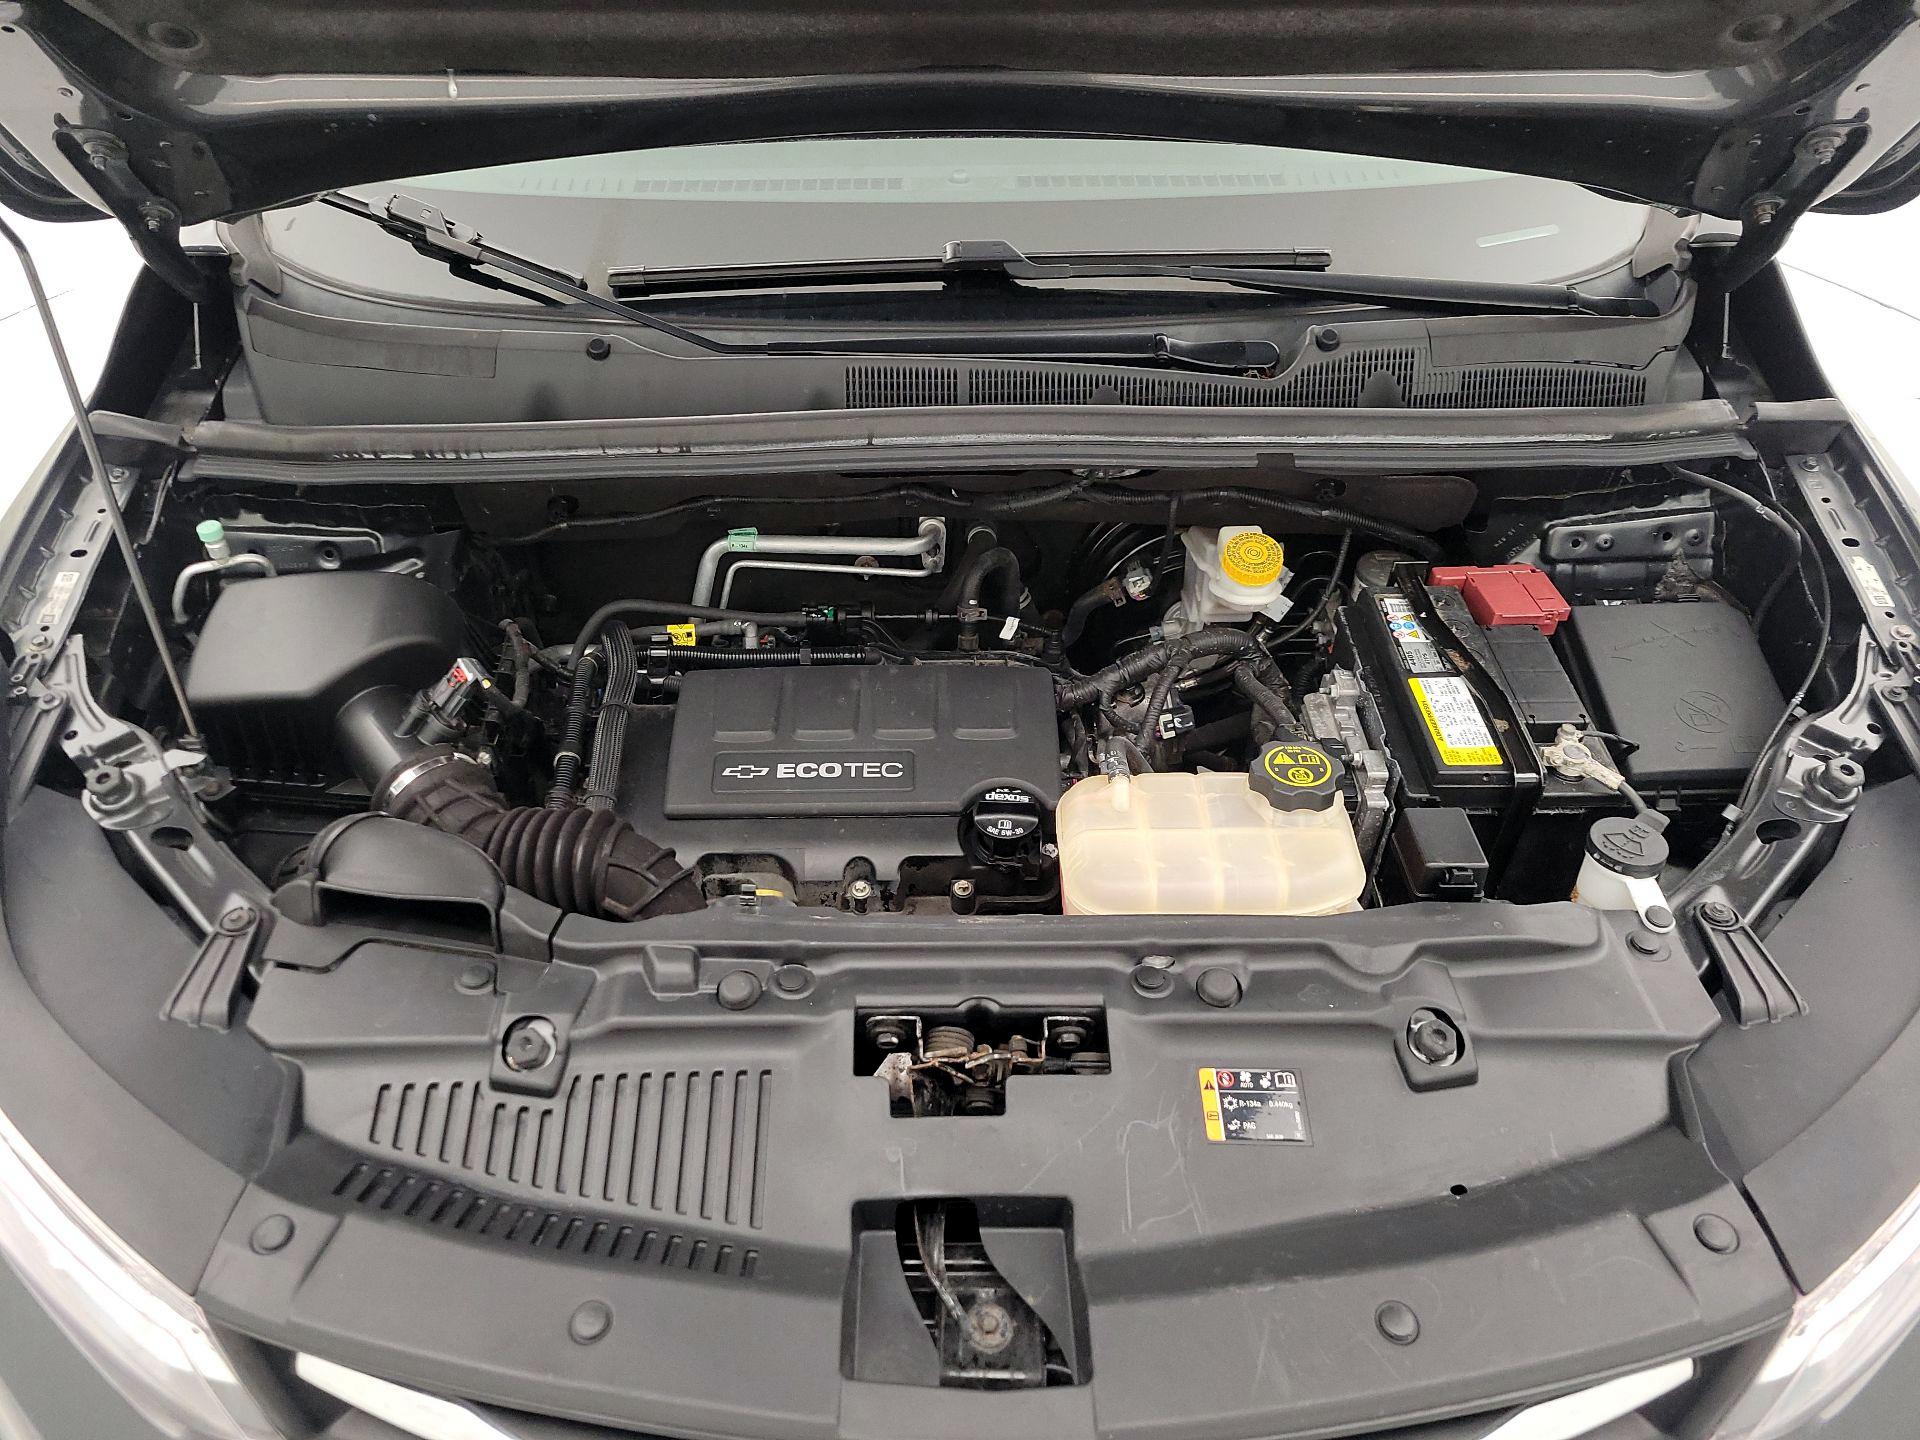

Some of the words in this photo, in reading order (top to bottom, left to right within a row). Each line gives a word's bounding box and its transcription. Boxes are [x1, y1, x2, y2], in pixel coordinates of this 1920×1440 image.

[776, 762, 904, 779] ECOTEC
[985, 791, 1030, 803] dexos
[986, 825, 1000, 836] SAE
[1001, 827, 1024, 836] 5W-30
[1239, 1099, 1262, 1108] R-134a
[1243, 1121, 1257, 1130] PAG
